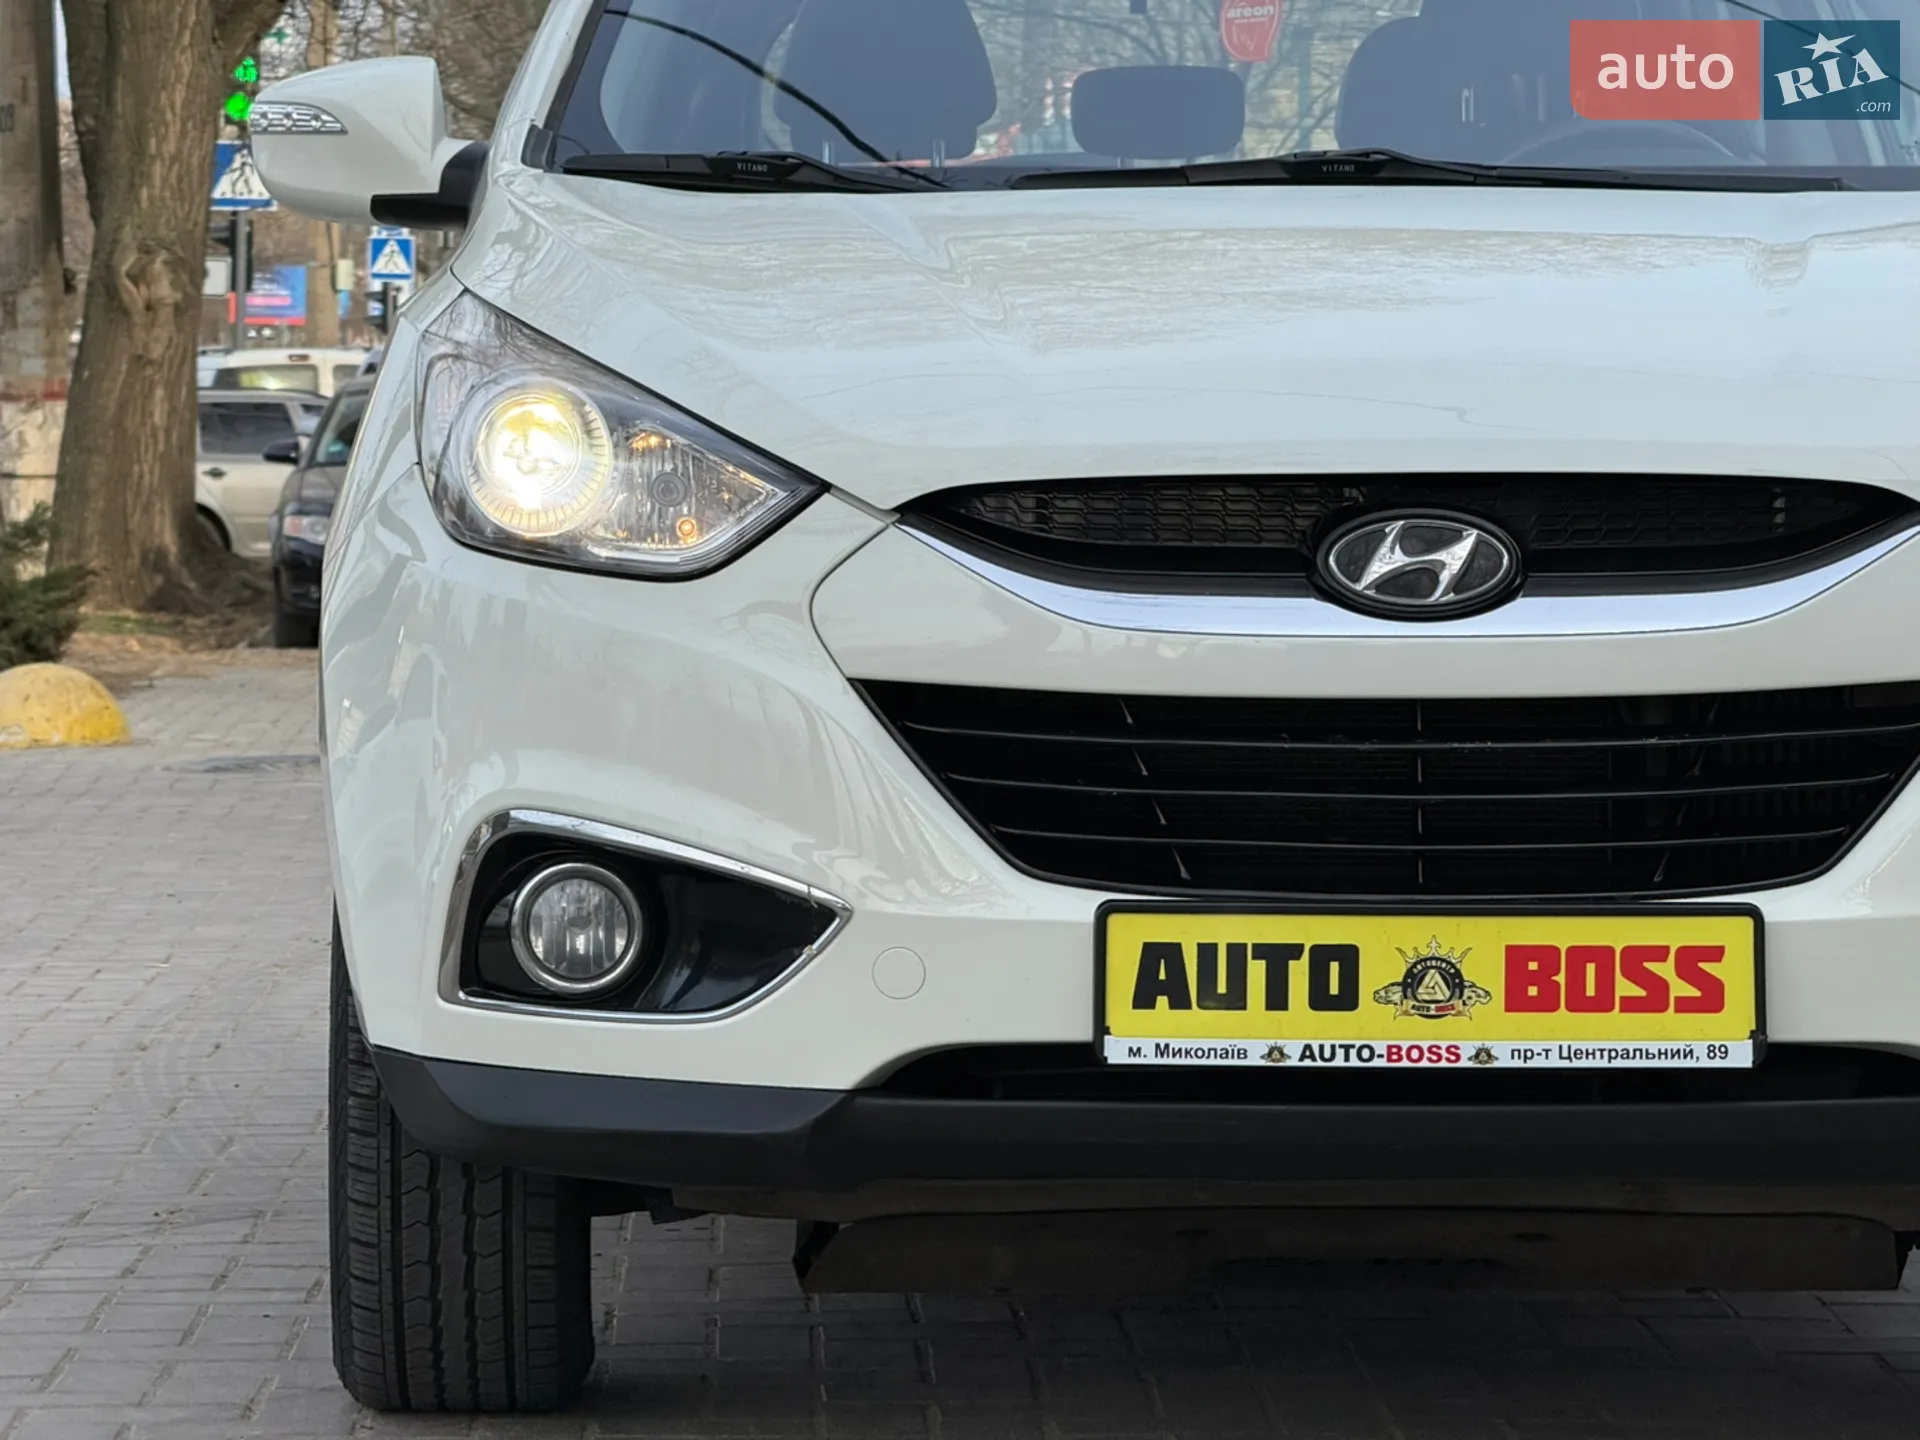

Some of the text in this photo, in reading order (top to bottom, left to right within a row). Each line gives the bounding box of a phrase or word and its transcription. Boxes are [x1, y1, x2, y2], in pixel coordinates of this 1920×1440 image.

[1227, 5, 1274, 18] areon
[737, 162, 768, 172] VITANO
[1322, 164, 1355, 172] VITANO
[1132, 942, 1725, 1014] AUTO BOSS
[1128, 1043, 1729, 1064] м. Миколаїв AUTO-BOSS пр-т Центральний, 89
